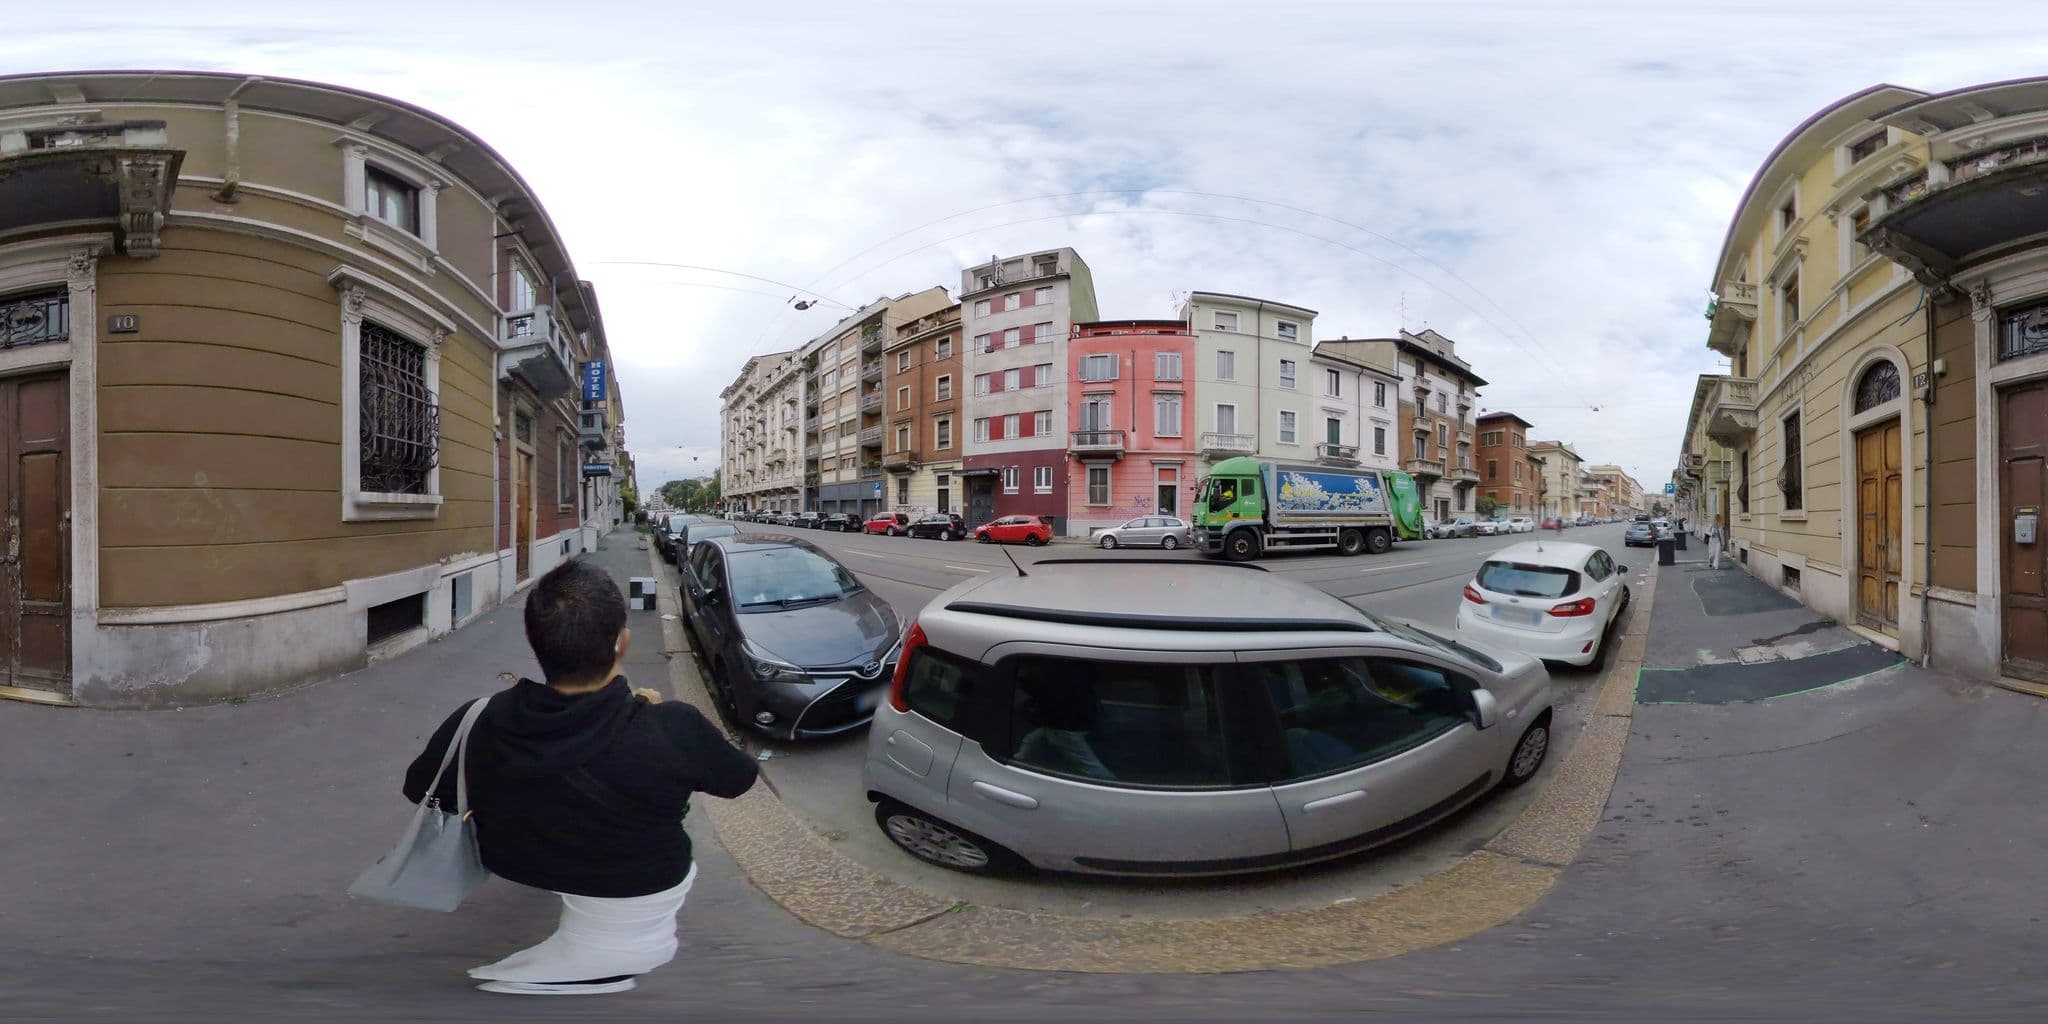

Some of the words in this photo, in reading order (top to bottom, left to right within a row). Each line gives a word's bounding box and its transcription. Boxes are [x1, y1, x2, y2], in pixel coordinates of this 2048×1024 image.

[115, 316, 134, 329] 10
[591, 361, 601, 398] HOTEL
[1915, 374, 1926, 388] 12
